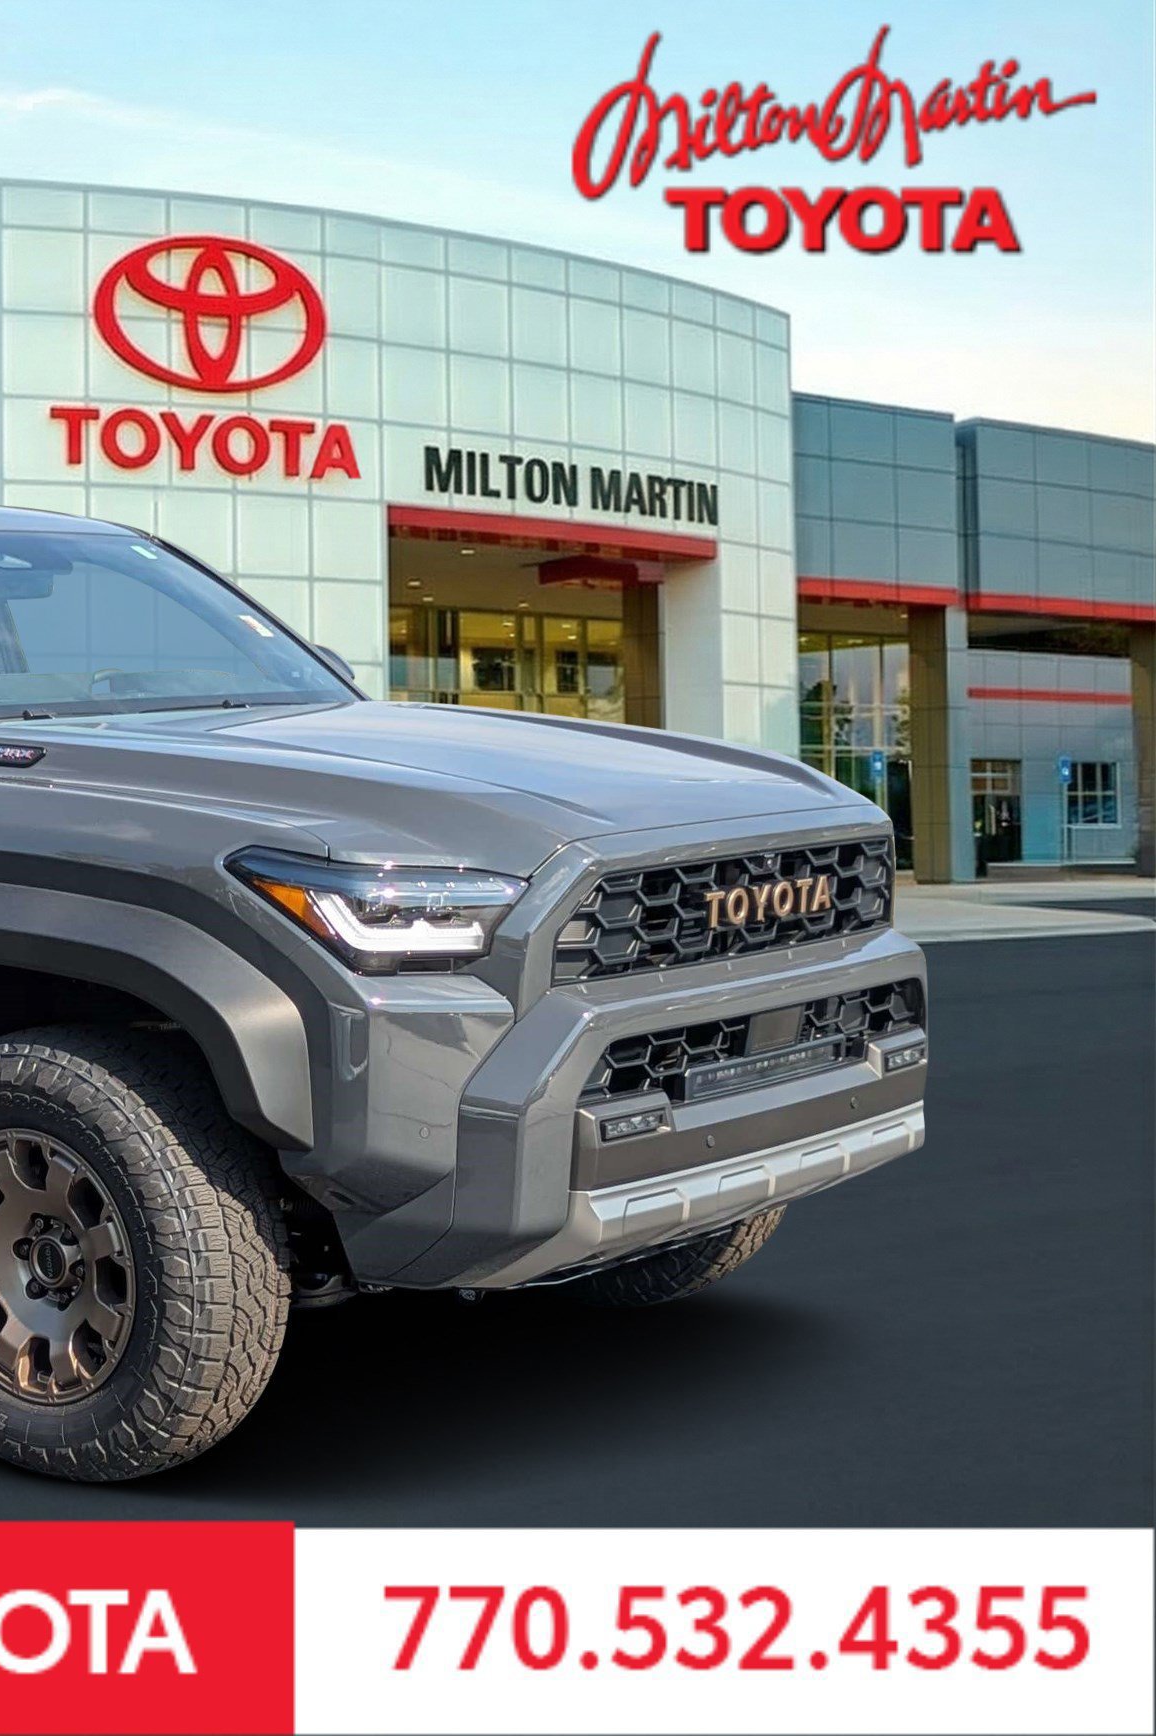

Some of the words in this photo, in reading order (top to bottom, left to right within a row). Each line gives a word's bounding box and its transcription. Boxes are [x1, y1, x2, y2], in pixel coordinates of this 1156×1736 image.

[50, 405, 361, 480] TOYOTA
[423, 446, 579, 507] MILTON
[590, 466, 719, 526] MARTIN
[704, 875, 832, 928] TOYOTA
